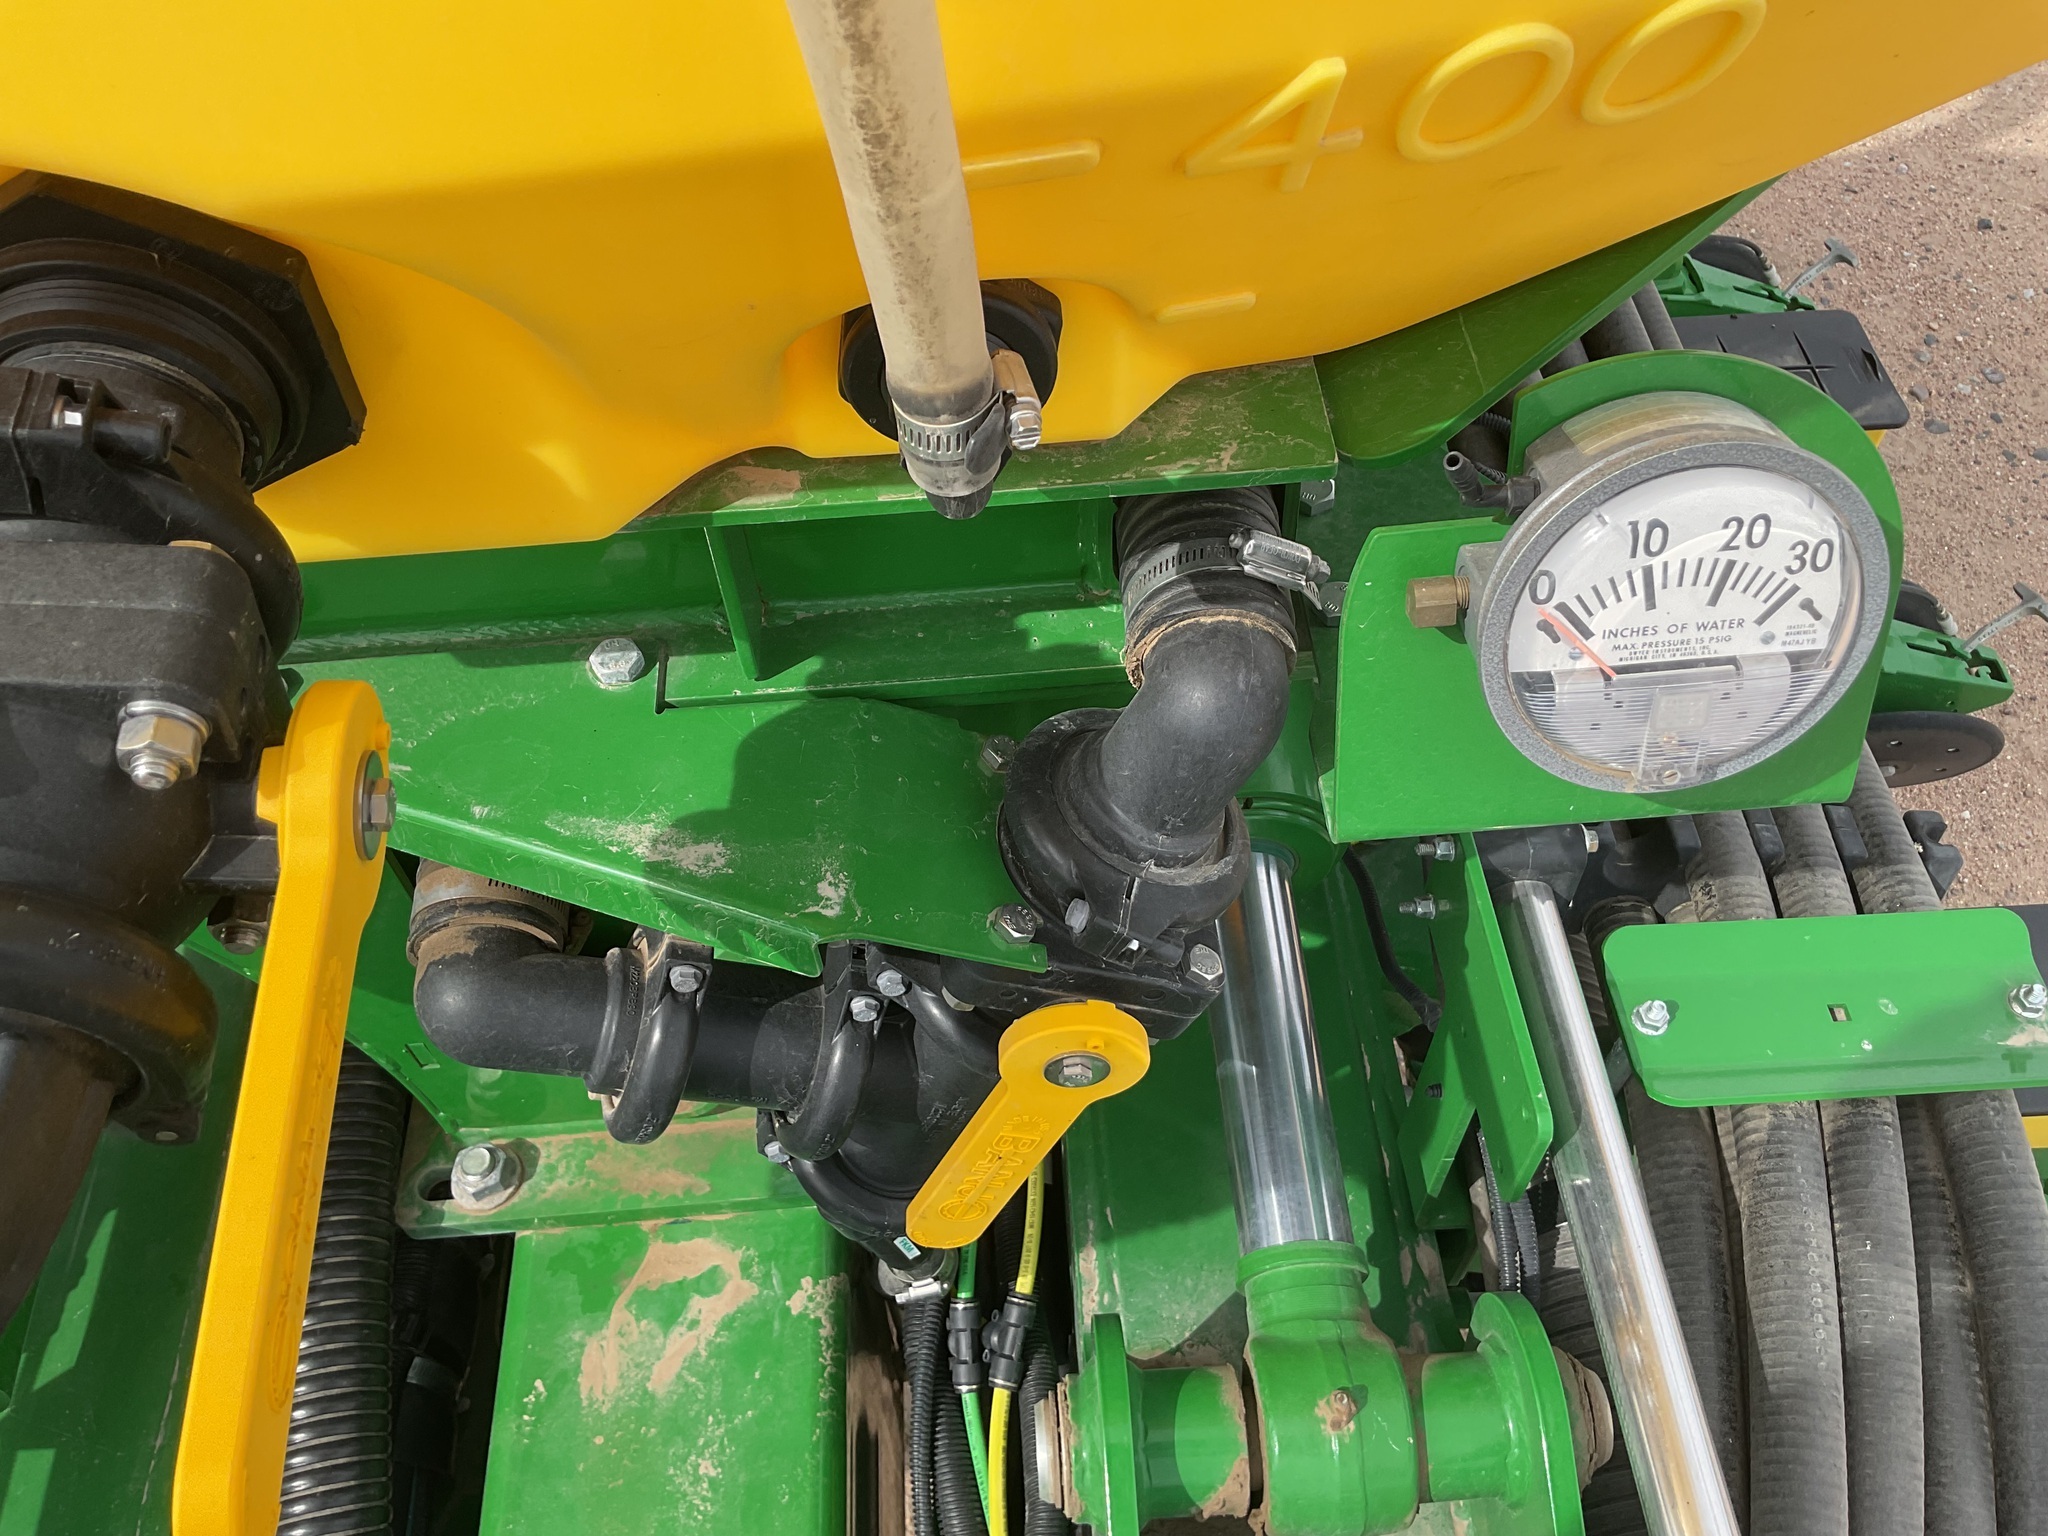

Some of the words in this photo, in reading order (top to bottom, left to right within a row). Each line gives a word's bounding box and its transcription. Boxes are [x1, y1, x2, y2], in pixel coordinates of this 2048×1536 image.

[1180, 0, 1768, 194] 400
[1627, 517, 1670, 559] 10
[1716, 512, 1772, 553] 20
[1783, 537, 1835, 576] 30
[1528, 569, 1557, 606] 0
[1601, 624, 1659, 640] INCHES
[1666, 622, 1689, 635] OF
[1695, 617, 1746, 632] WATER
[1611, 642, 1640, 652] MAX.
[1640, 638, 1692, 650] PRESSURE
[1694, 636, 1705, 646] 15
[1708, 633, 1733, 644] PSIG
[898, 1237, 915, 1253] FKM
